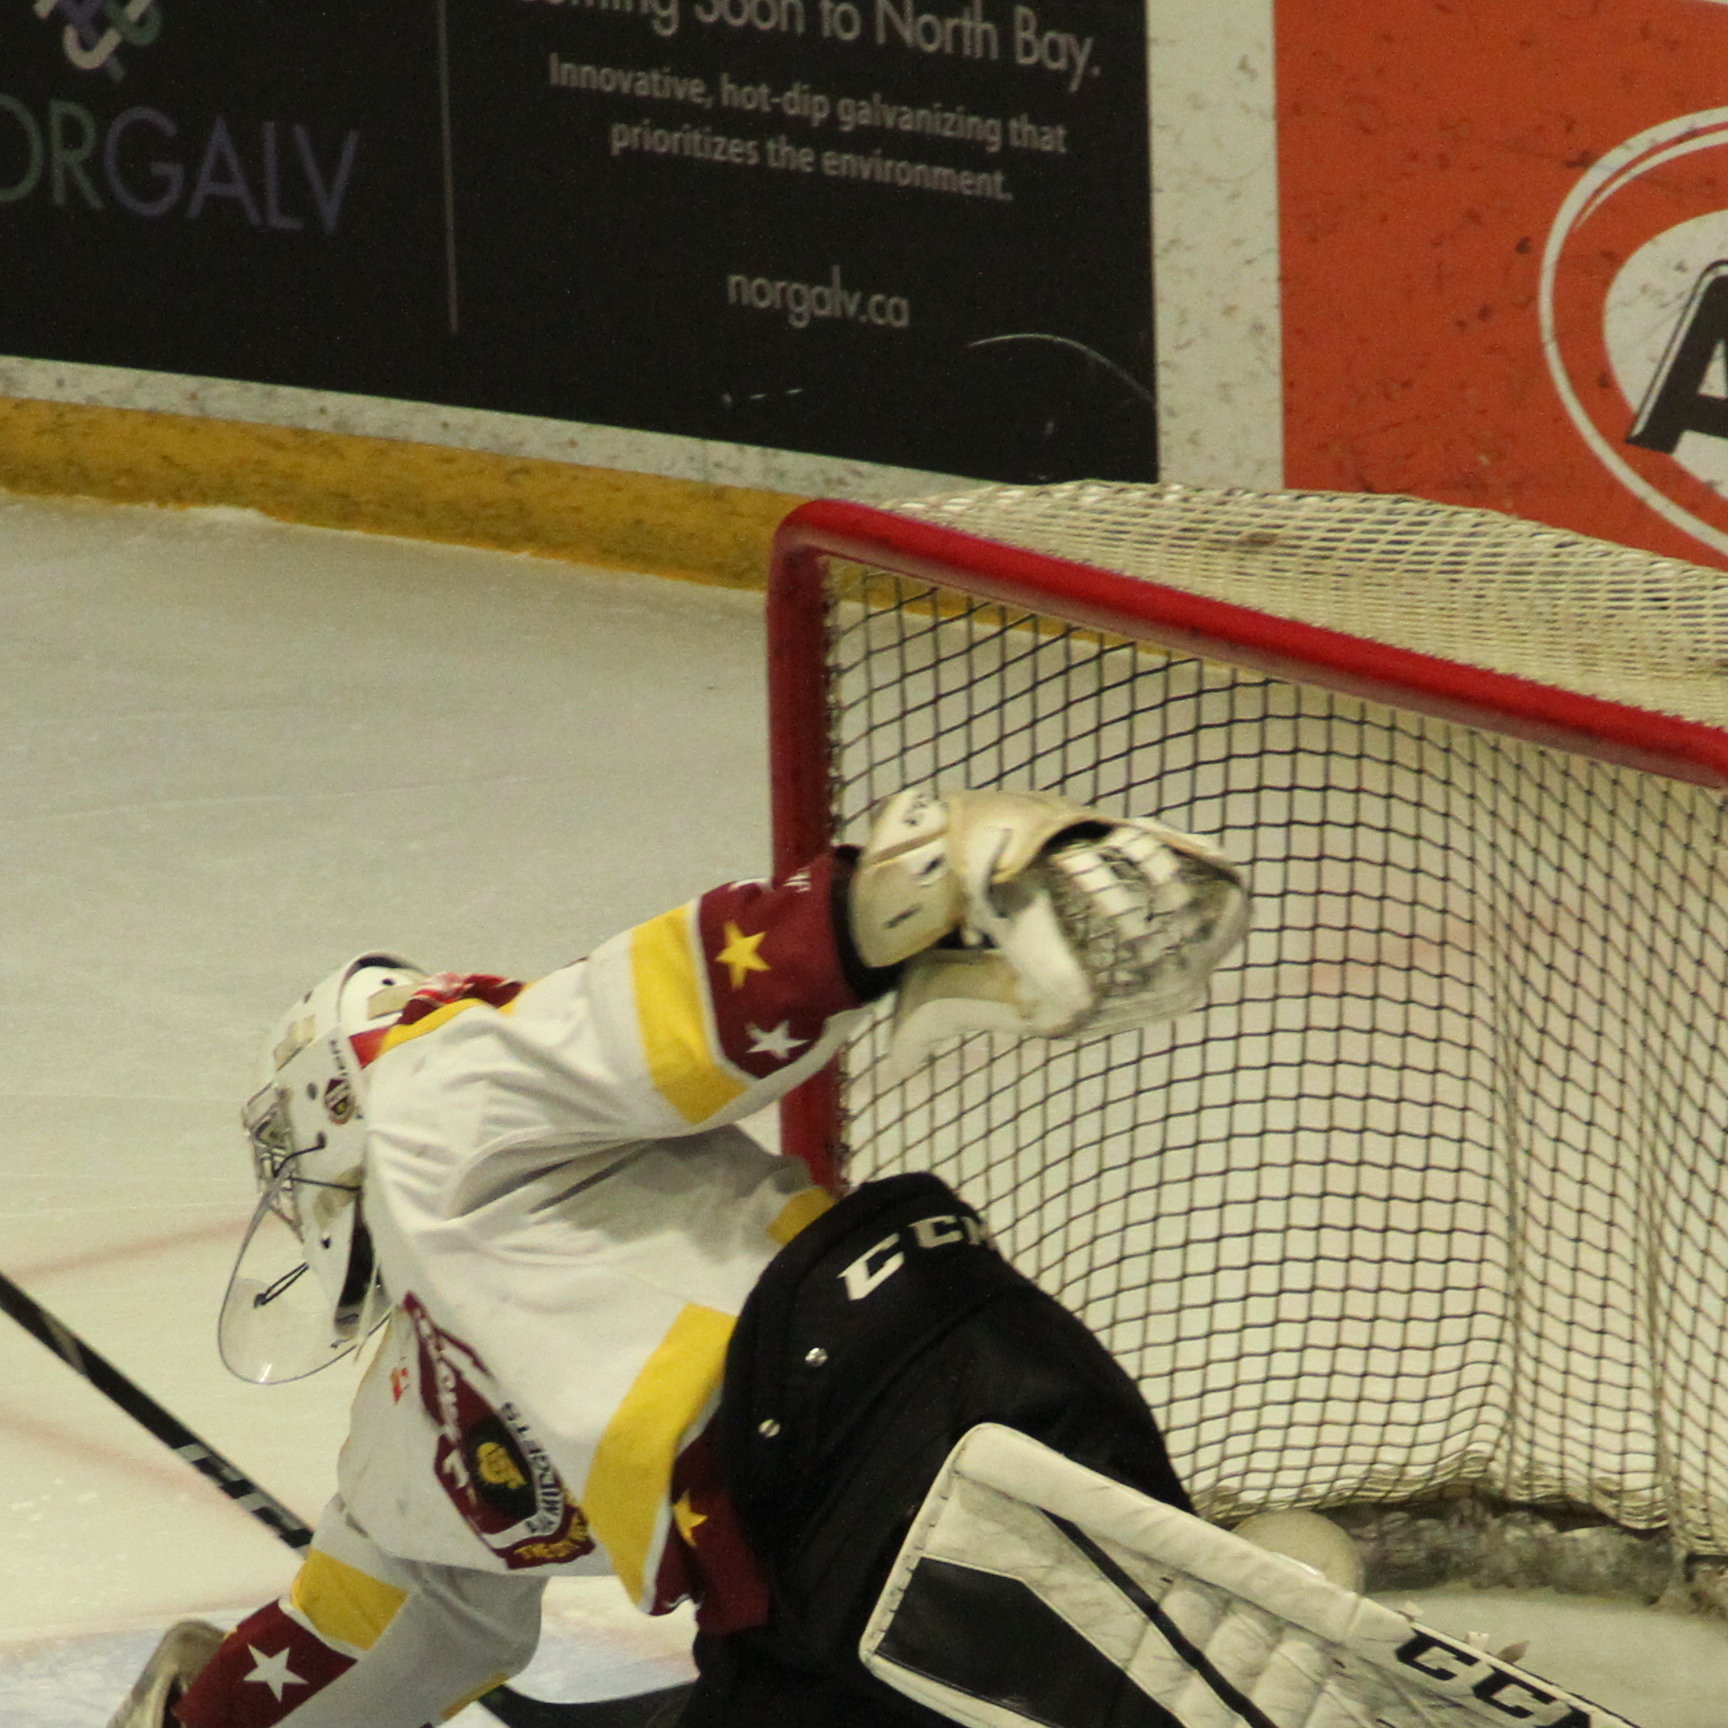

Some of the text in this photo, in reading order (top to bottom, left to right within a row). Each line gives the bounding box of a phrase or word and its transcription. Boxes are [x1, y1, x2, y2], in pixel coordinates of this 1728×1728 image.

[820, 0, 863, 41] to
[874, 0, 1000, 60] North
[1013, 4, 1101, 92] Bay.
[548, 51, 1067, 153] Innovative, hot-dip galvanizing that
[610, 117, 1014, 201] prioritizes the environment.
[727, 263, 911, 329] norgalv.ca
